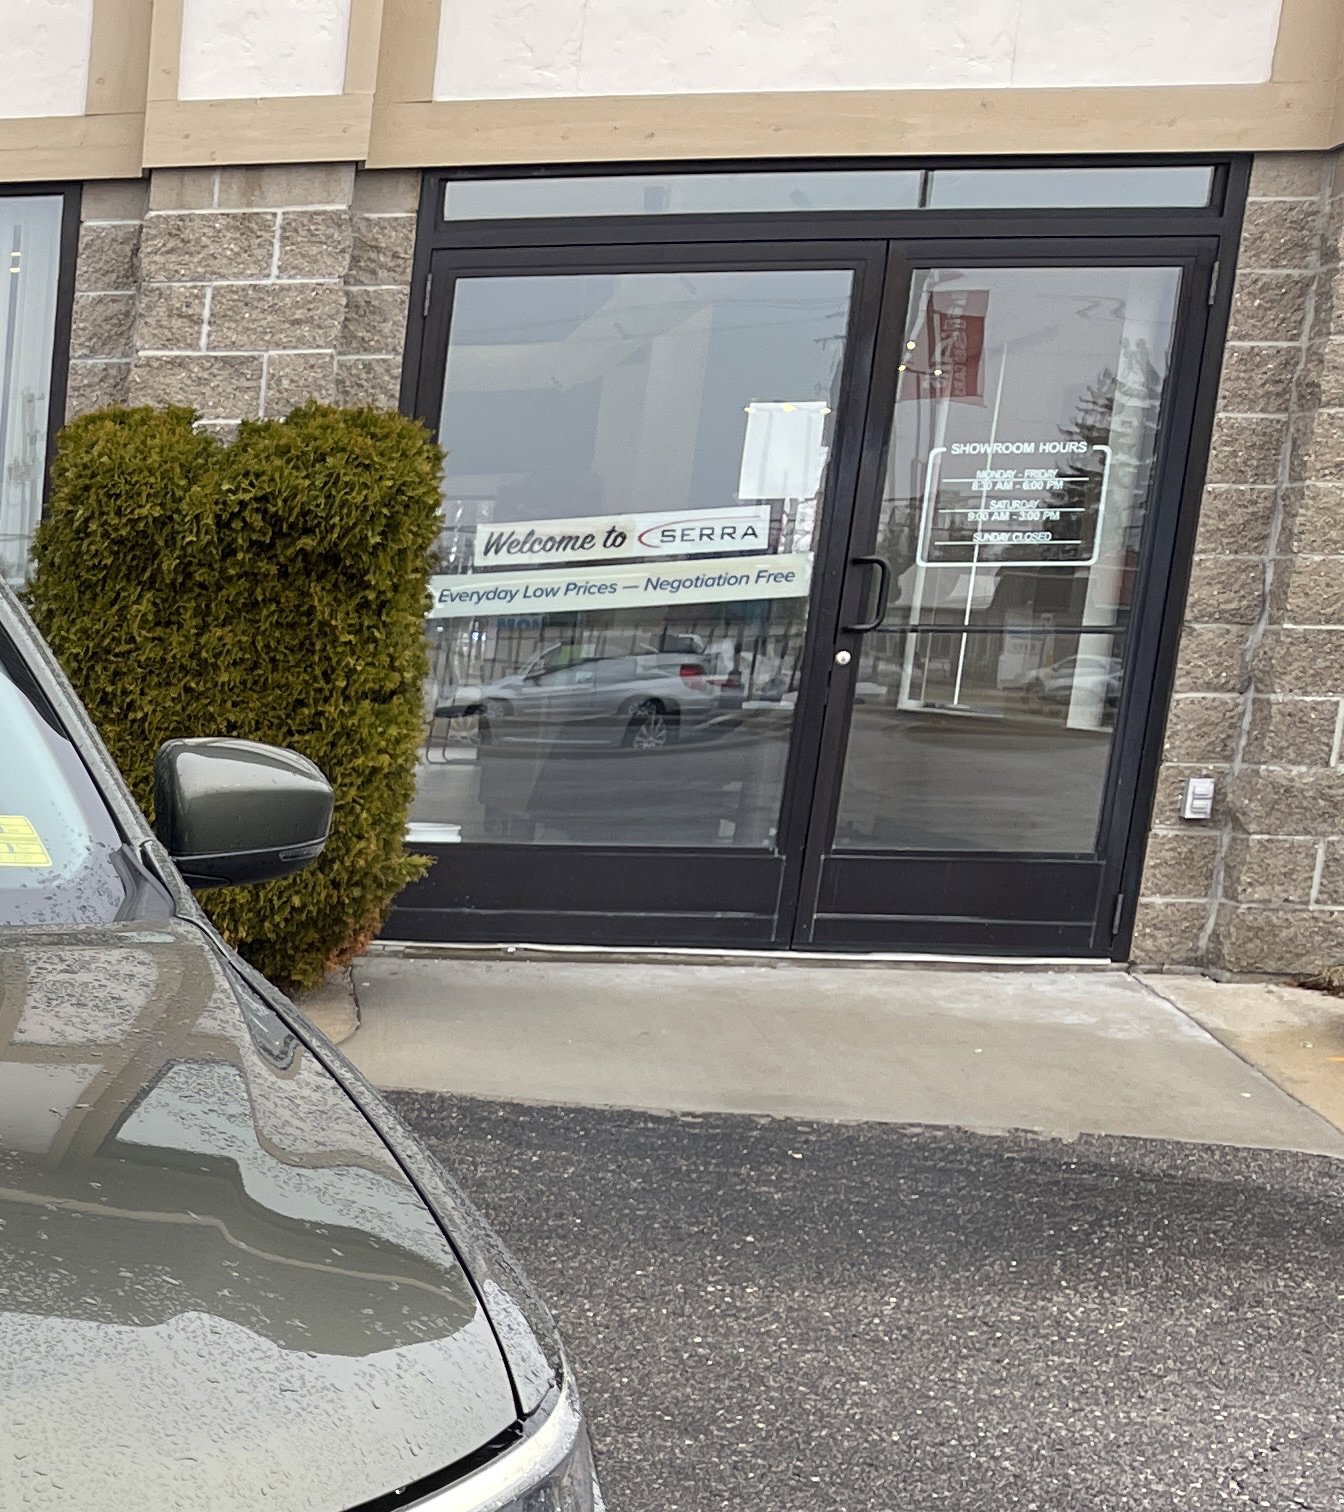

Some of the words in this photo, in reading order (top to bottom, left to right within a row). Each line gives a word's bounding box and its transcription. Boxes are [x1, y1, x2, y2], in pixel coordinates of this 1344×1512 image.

[951, 442, 1035, 455] SHOWROOM
[1039, 441, 1088, 453] HOURS
[976, 470, 1017, 479] MONDAY
[1024, 469, 1058, 478] FRIDAY
[995, 480, 1013, 490] AM
[1023, 480, 1043, 490] 6:00
[1046, 480, 1063, 490] PM
[989, 500, 1039, 510] SATURDAY
[967, 512, 989, 521] 9:00
[991, 512, 1009, 521] AM
[1019, 511, 1040, 521] 3:00
[1042, 511, 1060, 521] PM
[483, 529, 596, 557] Welcome
[603, 525, 627, 549] to
[660, 526, 759, 543] SERRA
[973, 532, 1011, 541] SUNDAY
[1012, 531, 1052, 541] CLOSED
[438, 587, 519, 605] Everyday
[522, 585, 561, 599] Low
[564, 581, 618, 596] Prices
[644, 572, 750, 593] Negotiation
[754, 569, 796, 584] Free
